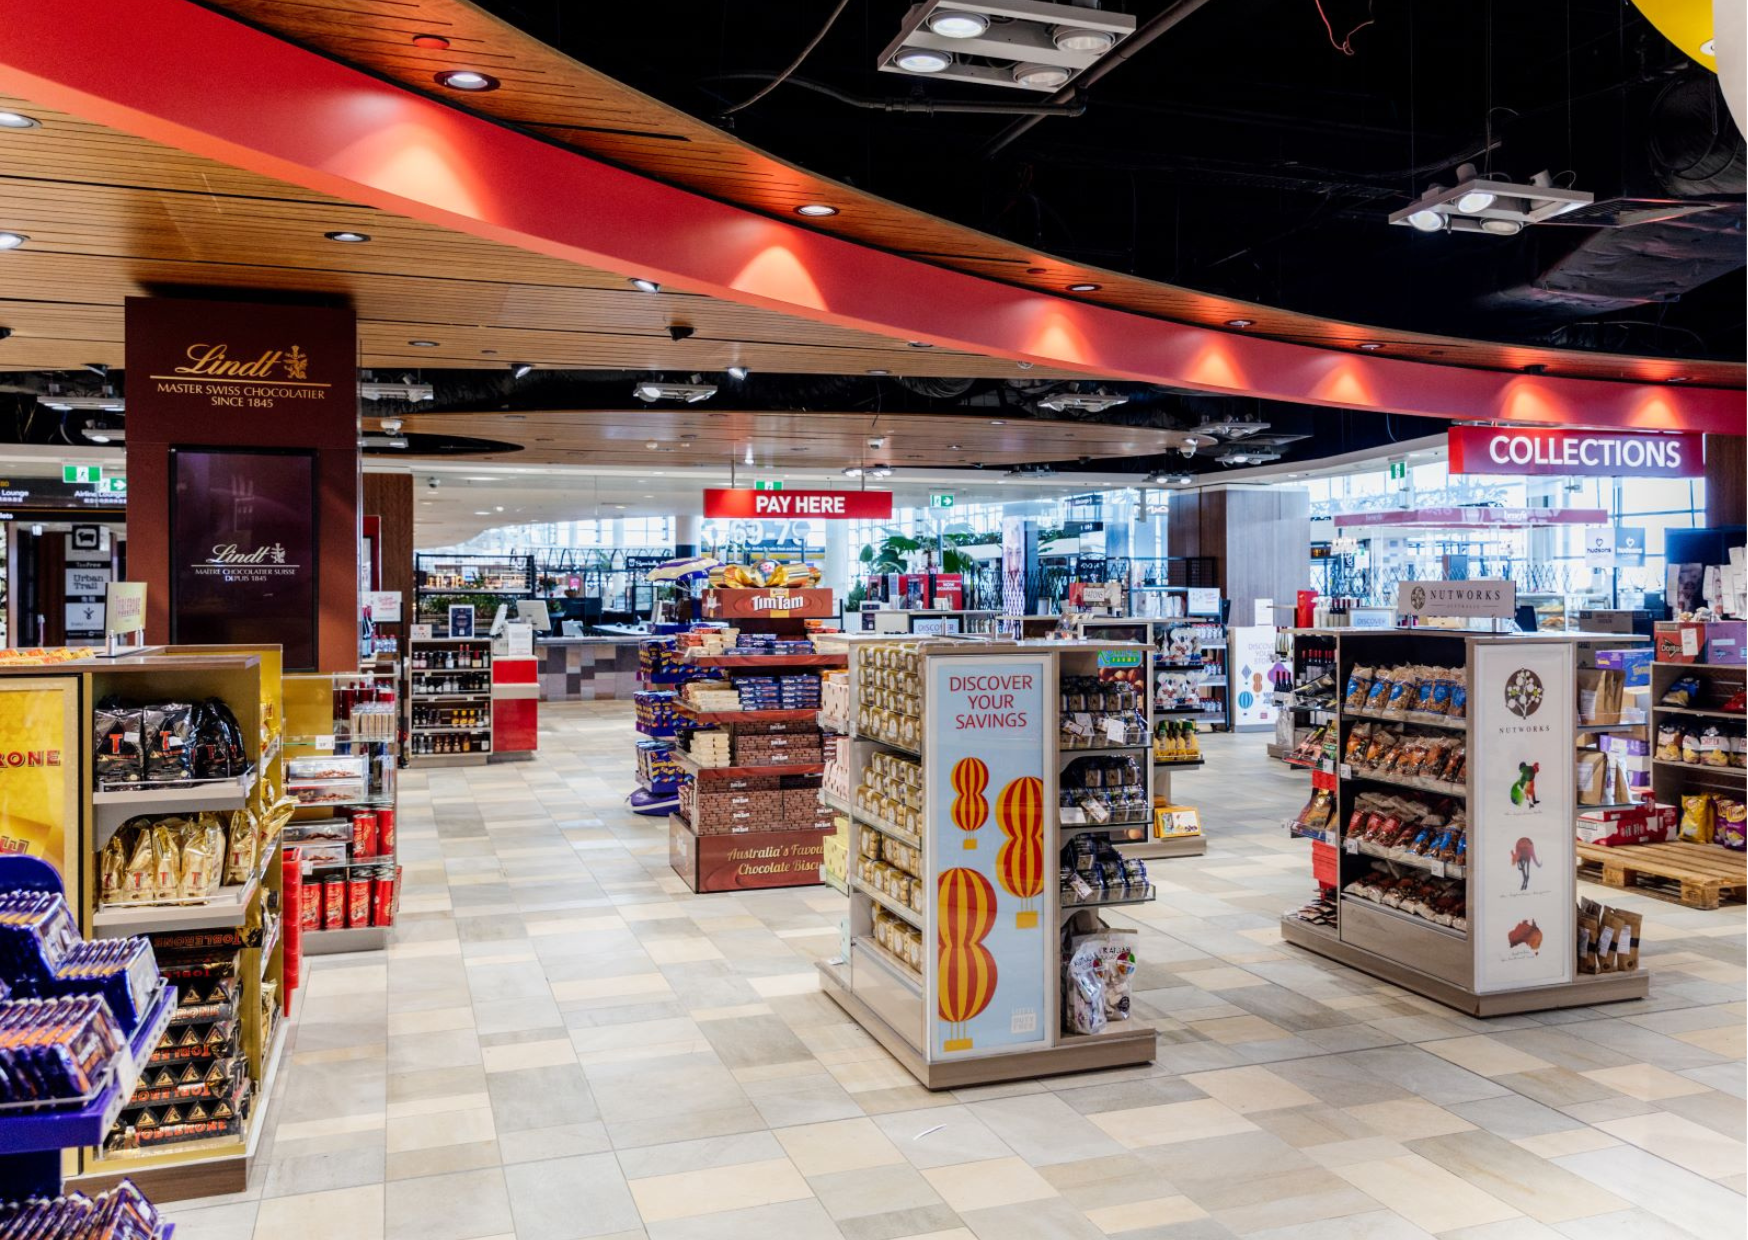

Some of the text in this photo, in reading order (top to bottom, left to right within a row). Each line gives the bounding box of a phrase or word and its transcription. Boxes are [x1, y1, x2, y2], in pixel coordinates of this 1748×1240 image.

[174, 344, 282, 378] Lindt
[157, 383, 325, 400] MASTER SWISS CHOCOLATIER
[211, 396, 274, 408] SINCE 1845
[1490, 436, 1682, 468] COLLECTIONS
[756, 496, 846, 514] PAY HERE
[206, 544, 270, 564] Lindt
[1430, 590, 1500, 600] NUTWORKS
[950, 675, 1033, 692] DISCOVER
[968, 694, 1014, 710] YOUR
[956, 712, 1027, 729] SAVINGS
[1500, 725, 1550, 734] NUTWORKS
[109, 734, 123, 754] T
[160, 731, 172, 750] T
[726, 846, 789, 861] Australia's
[738, 862, 790, 876] Chocolate
[154, 929, 242, 948] TOBLERONE
[135, 1119, 227, 1144] TOBLERONE
